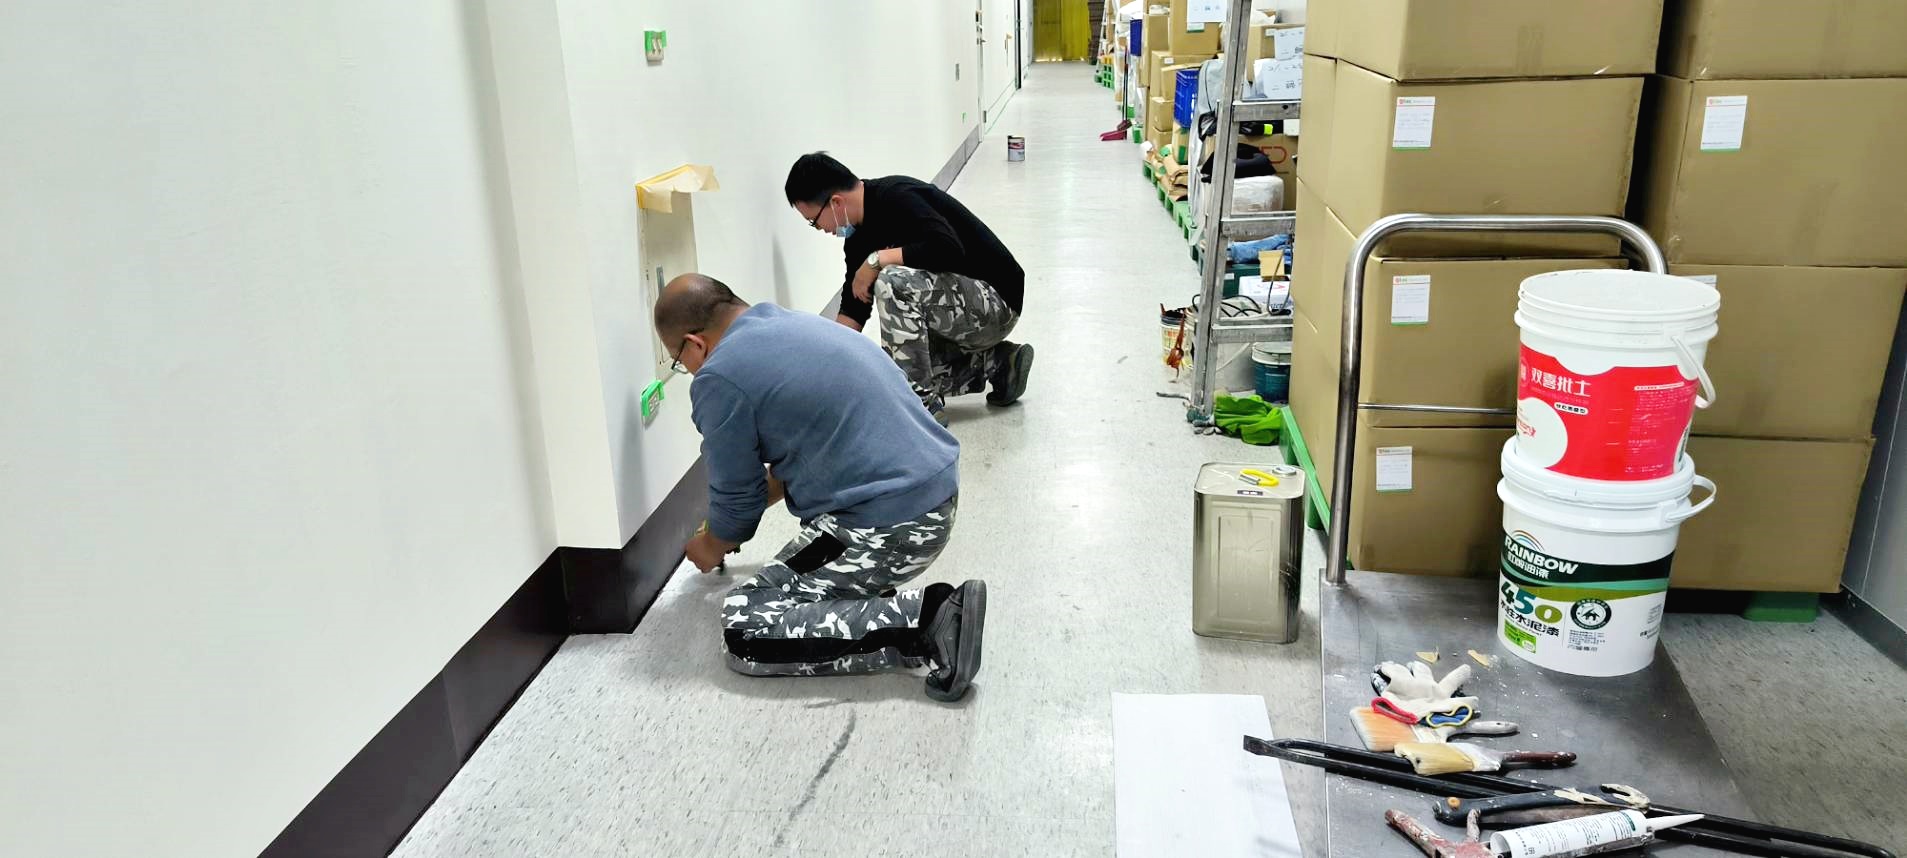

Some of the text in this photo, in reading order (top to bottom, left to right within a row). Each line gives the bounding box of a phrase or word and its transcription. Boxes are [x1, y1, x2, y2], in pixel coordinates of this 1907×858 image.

[1531, 367, 1593, 397] 双喜批土
[1504, 535, 1579, 575] RAINBOW
[1507, 551, 1550, 579] 虹牌油漆
[1501, 581, 1563, 624] 450
